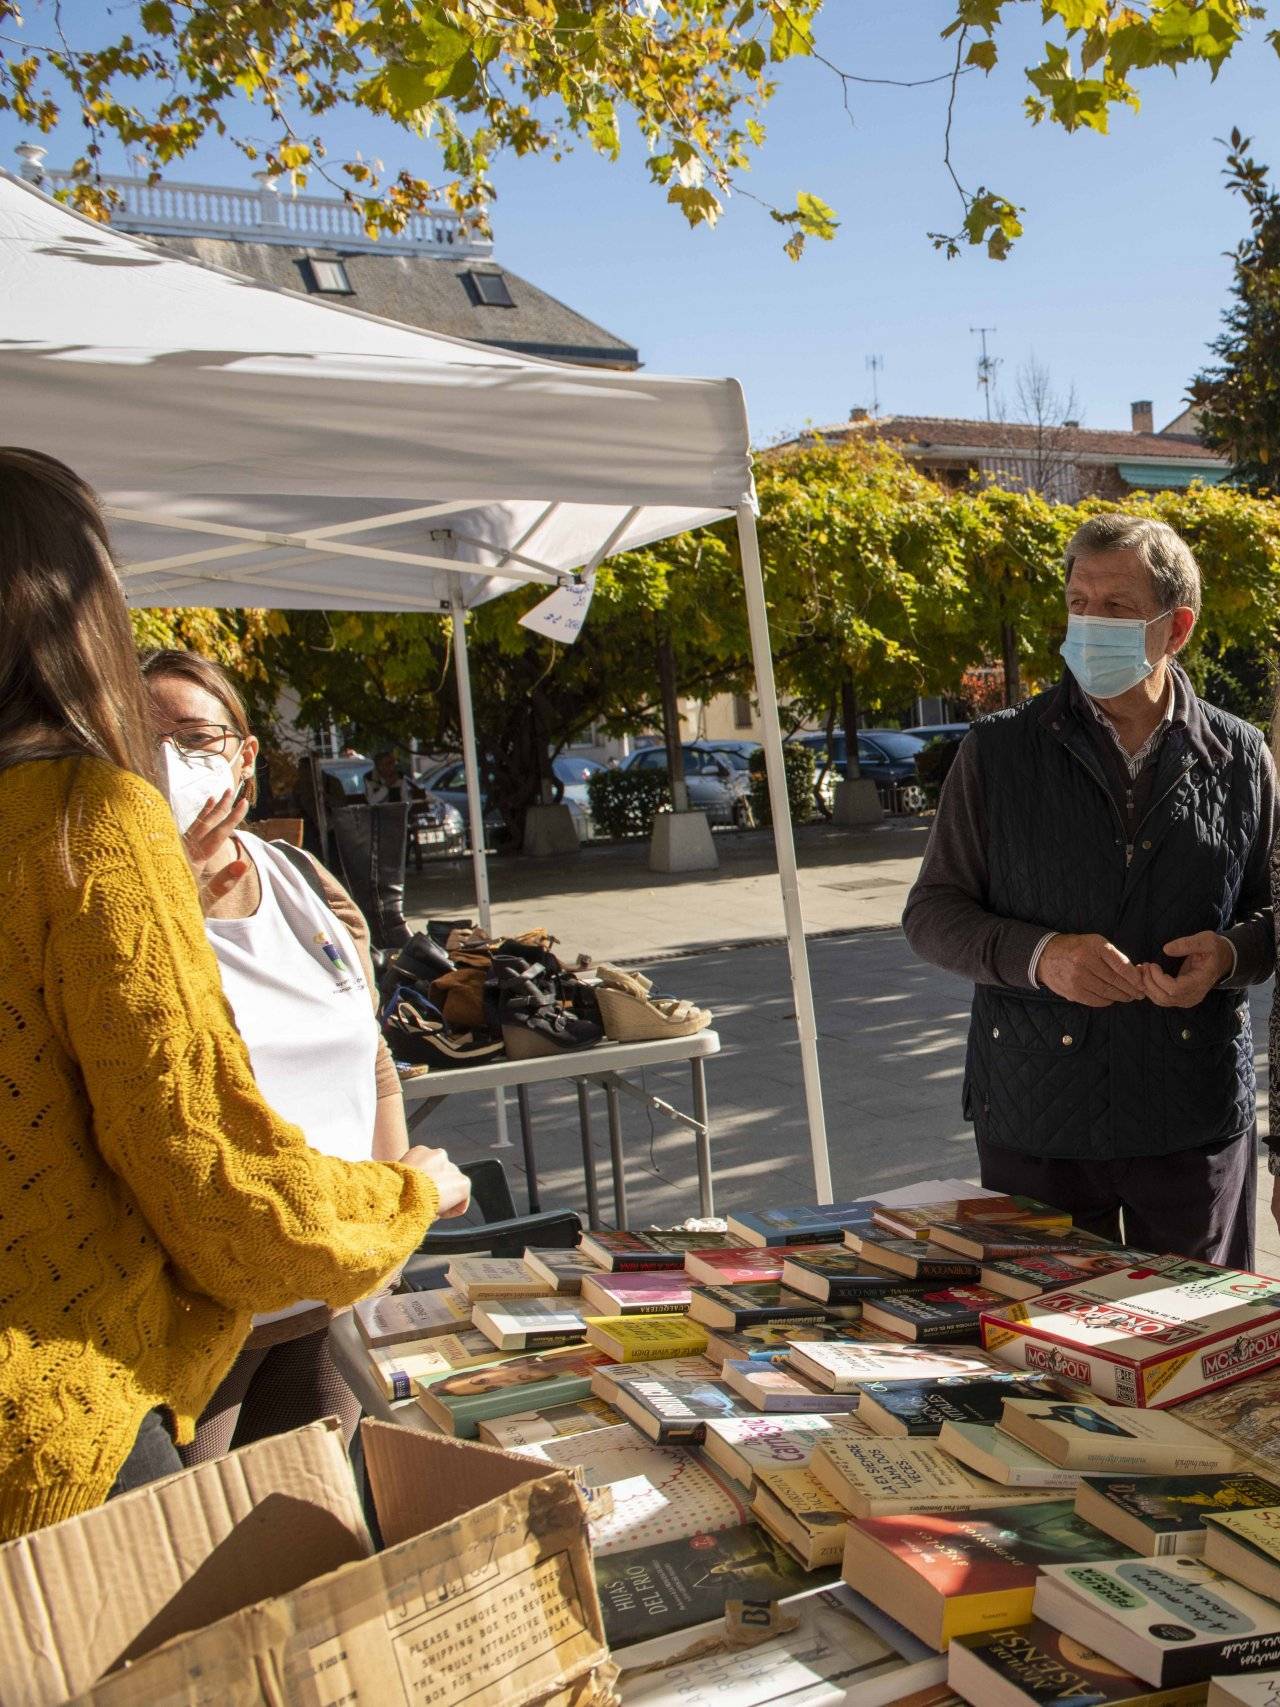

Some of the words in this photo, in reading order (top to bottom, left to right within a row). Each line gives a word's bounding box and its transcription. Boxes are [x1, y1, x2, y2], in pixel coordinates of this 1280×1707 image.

[741, 1419, 806, 1461] Carnegie
[845, 1444, 881, 1474] SIEMPRE
[868, 1449, 890, 1464] DOS
[883, 1465, 912, 1489] LLAMA
[1071, 1571, 1136, 1609] FEDERICO
[1084, 1569, 1135, 1599] MOCCIA
[1132, 1574, 1185, 1605] metros
[1145, 1568, 1182, 1588] cielo
[609, 1581, 637, 1612] HIJAS
[642, 1591, 668, 1615] DEL
[1195, 1595, 1240, 1620] sobre
[409, 1628, 450, 1655] PLEASE
[456, 1603, 498, 1633] REMOVE
[502, 1590, 526, 1609] THIS
[1184, 1604, 1214, 1623] tres
[421, 1634, 474, 1670] SHIPPING
[478, 1620, 500, 1639] BOX
[505, 1610, 518, 1626] TO
[521, 1590, 559, 1615] REVEAL
[412, 1675, 435, 1693] THE
[439, 1653, 474, 1677] TRULY
[479, 1616, 541, 1657] ATTRACTIVE
[424, 1688, 447, 1705] BOX
[452, 1672, 473, 1691] FOR
[477, 1643, 528, 1680] IN-STORE
[531, 1616, 572, 1647] DISPLAY
[1220, 1642, 1250, 1660] cielo
[1250, 1641, 1260, 1653] el
[696, 1659, 736, 1693] RUIZ
[988, 1629, 1108, 1700] ASENSI
